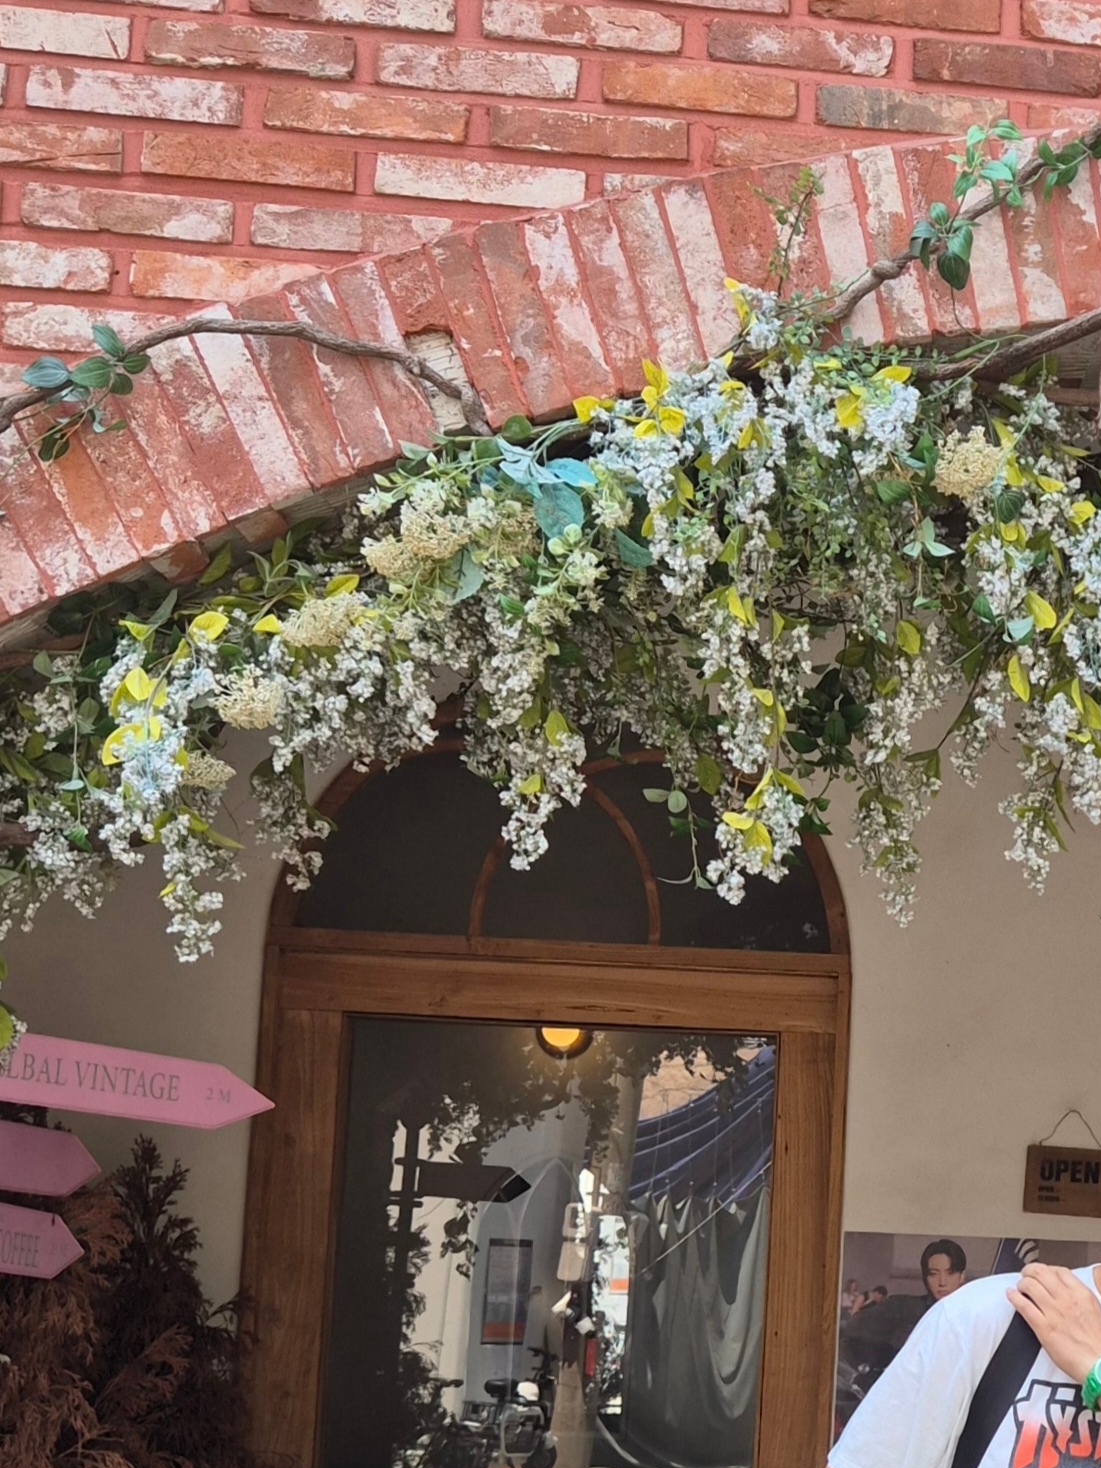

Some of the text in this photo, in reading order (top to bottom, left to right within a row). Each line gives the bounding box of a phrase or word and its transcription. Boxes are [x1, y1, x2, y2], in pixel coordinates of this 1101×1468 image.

[0, 1051, 181, 1102] LBAL VINTAGE
[1040, 1158, 1100, 1185] OPEN
[0, 1228, 41, 1269] OFFEE
